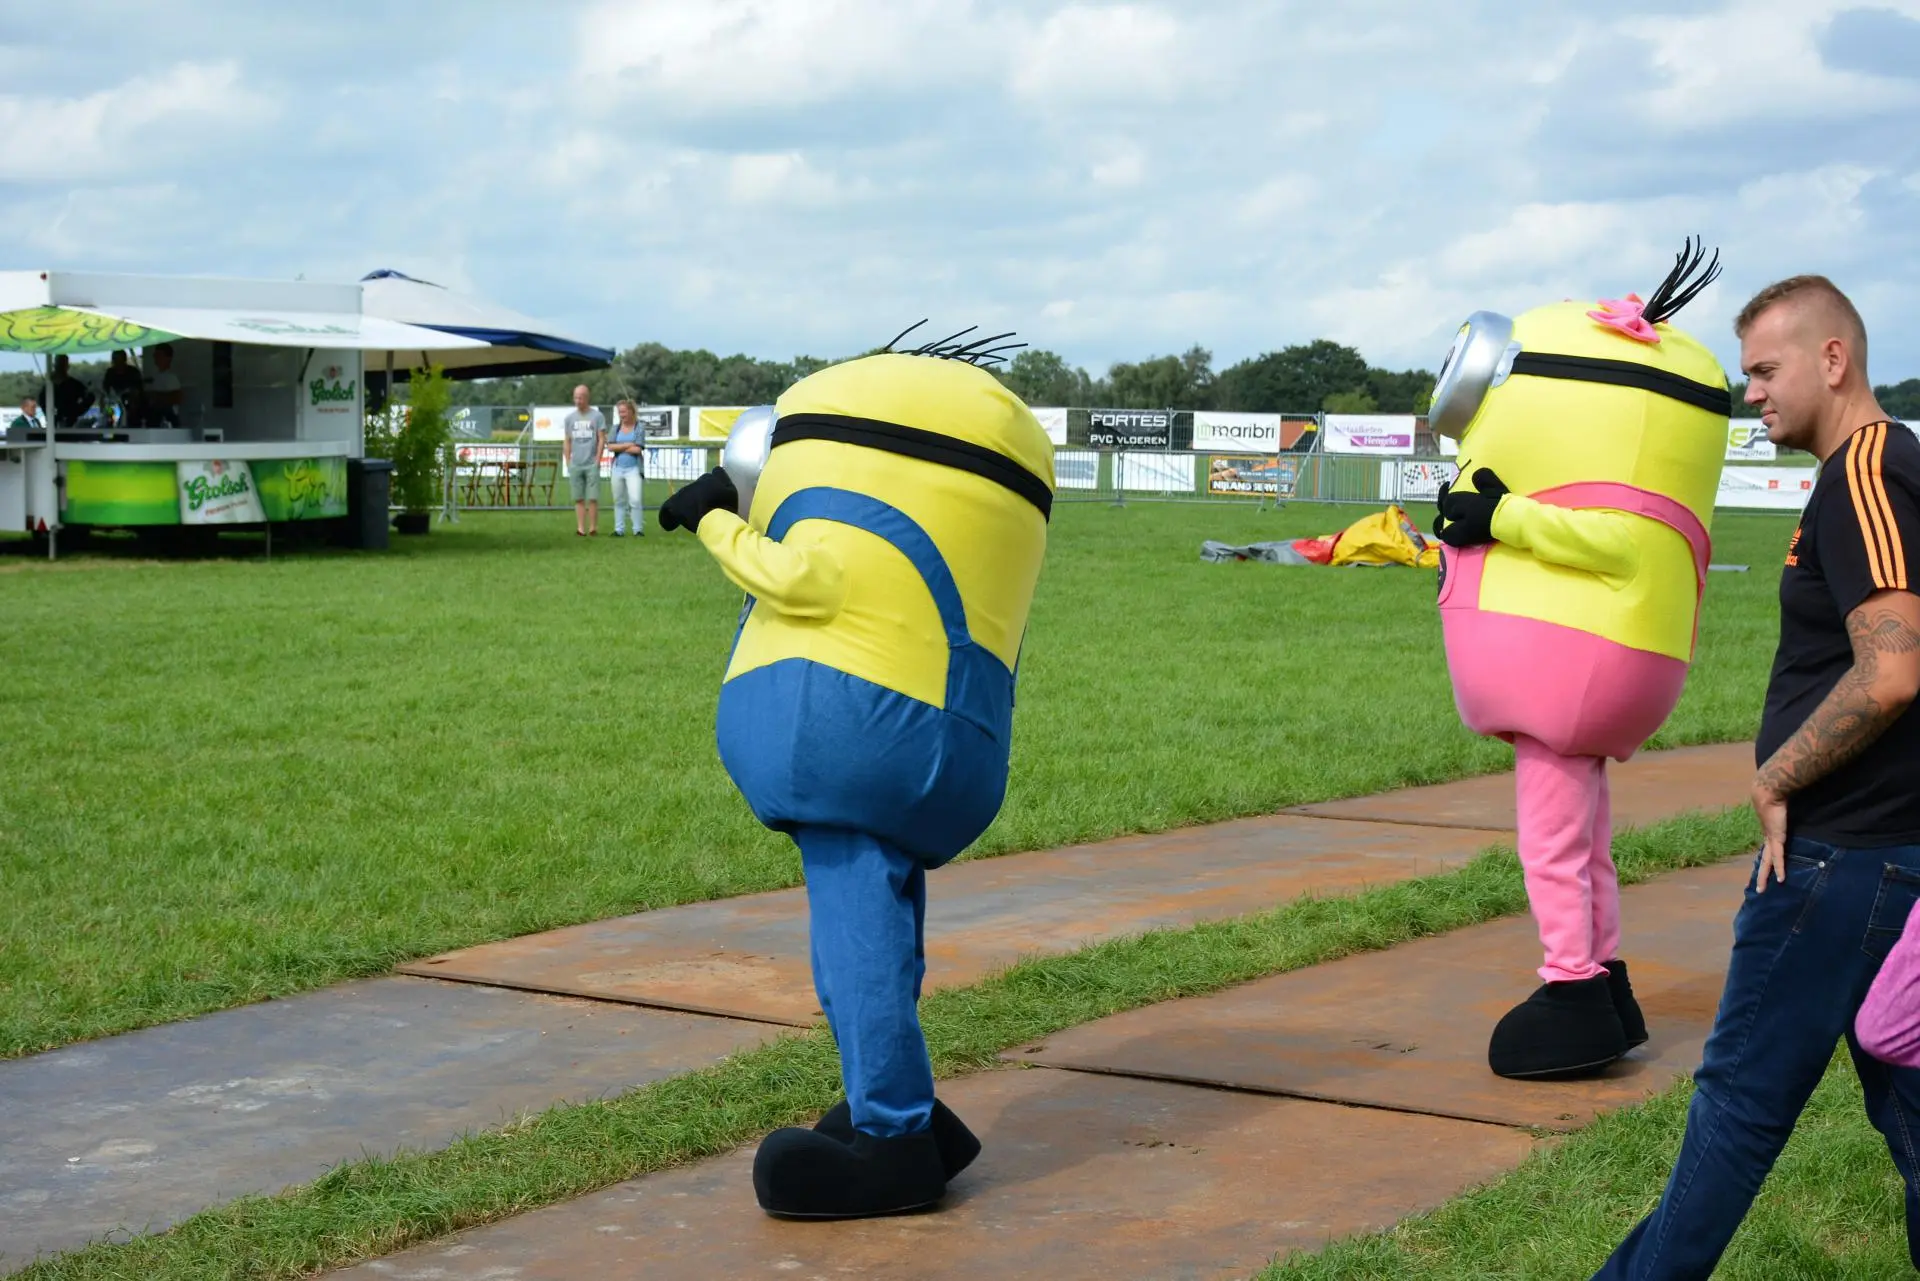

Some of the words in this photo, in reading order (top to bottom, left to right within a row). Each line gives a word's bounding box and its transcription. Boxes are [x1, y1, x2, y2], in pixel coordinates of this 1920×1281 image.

[1091, 414, 1168, 427] FORTES
[1212, 424, 1275, 439] maribri
[1090, 434, 1113, 444] PVC
[1117, 436, 1167, 445] VLOEREN
[183, 472, 249, 511] Grolsch
